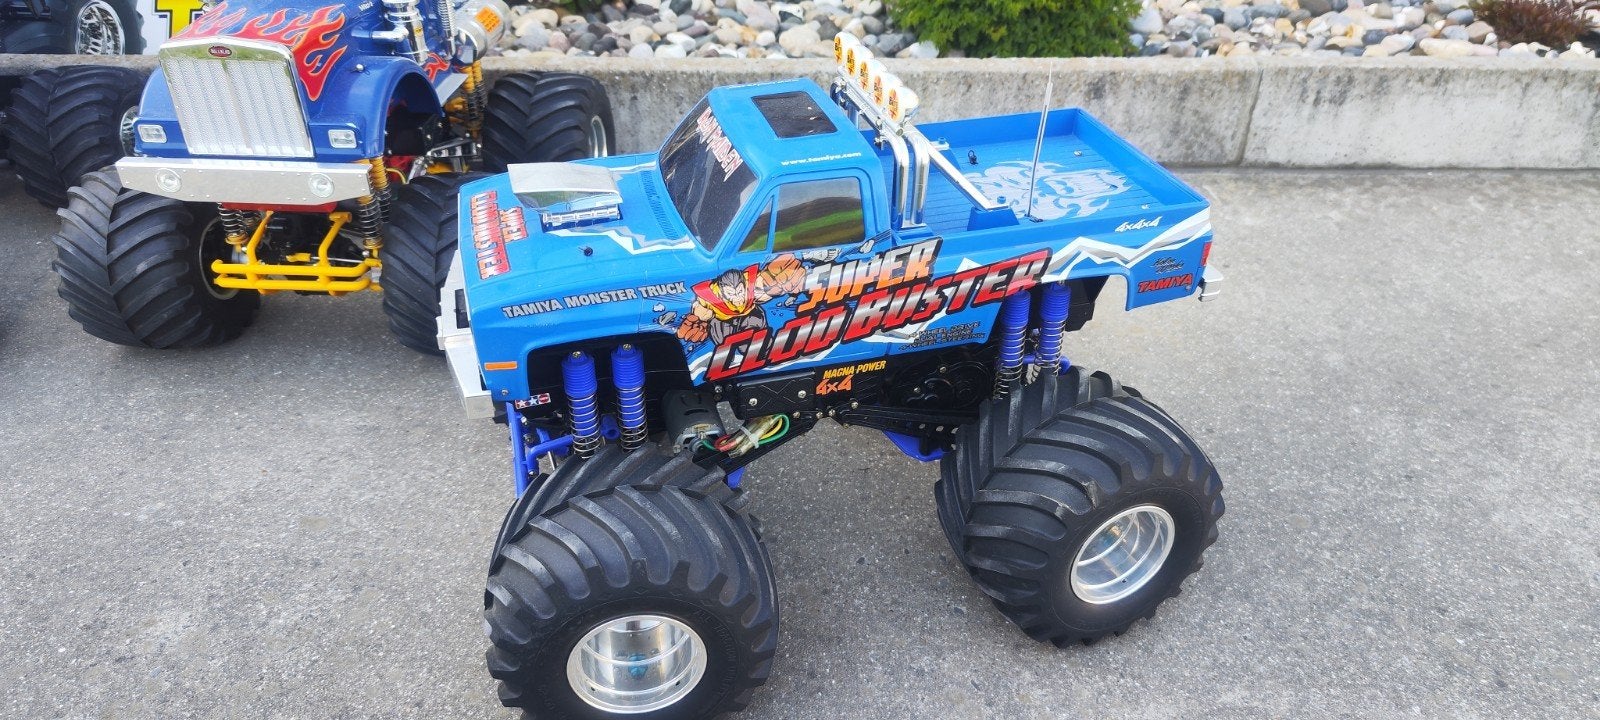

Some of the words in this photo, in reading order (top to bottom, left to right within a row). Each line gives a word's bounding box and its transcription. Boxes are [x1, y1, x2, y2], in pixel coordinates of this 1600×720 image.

[780, 151, 862, 166] www.tamiya.com
[798, 238, 942, 313] SUPER
[1138, 273, 1193, 293] TAMIYA
[502, 299, 564, 318] TAMIYA
[563, 288, 637, 312] MONSTER
[638, 281, 687, 298] TRUCK
[823, 366, 855, 379] MAGNA
[855, 360, 887, 373] POWER
